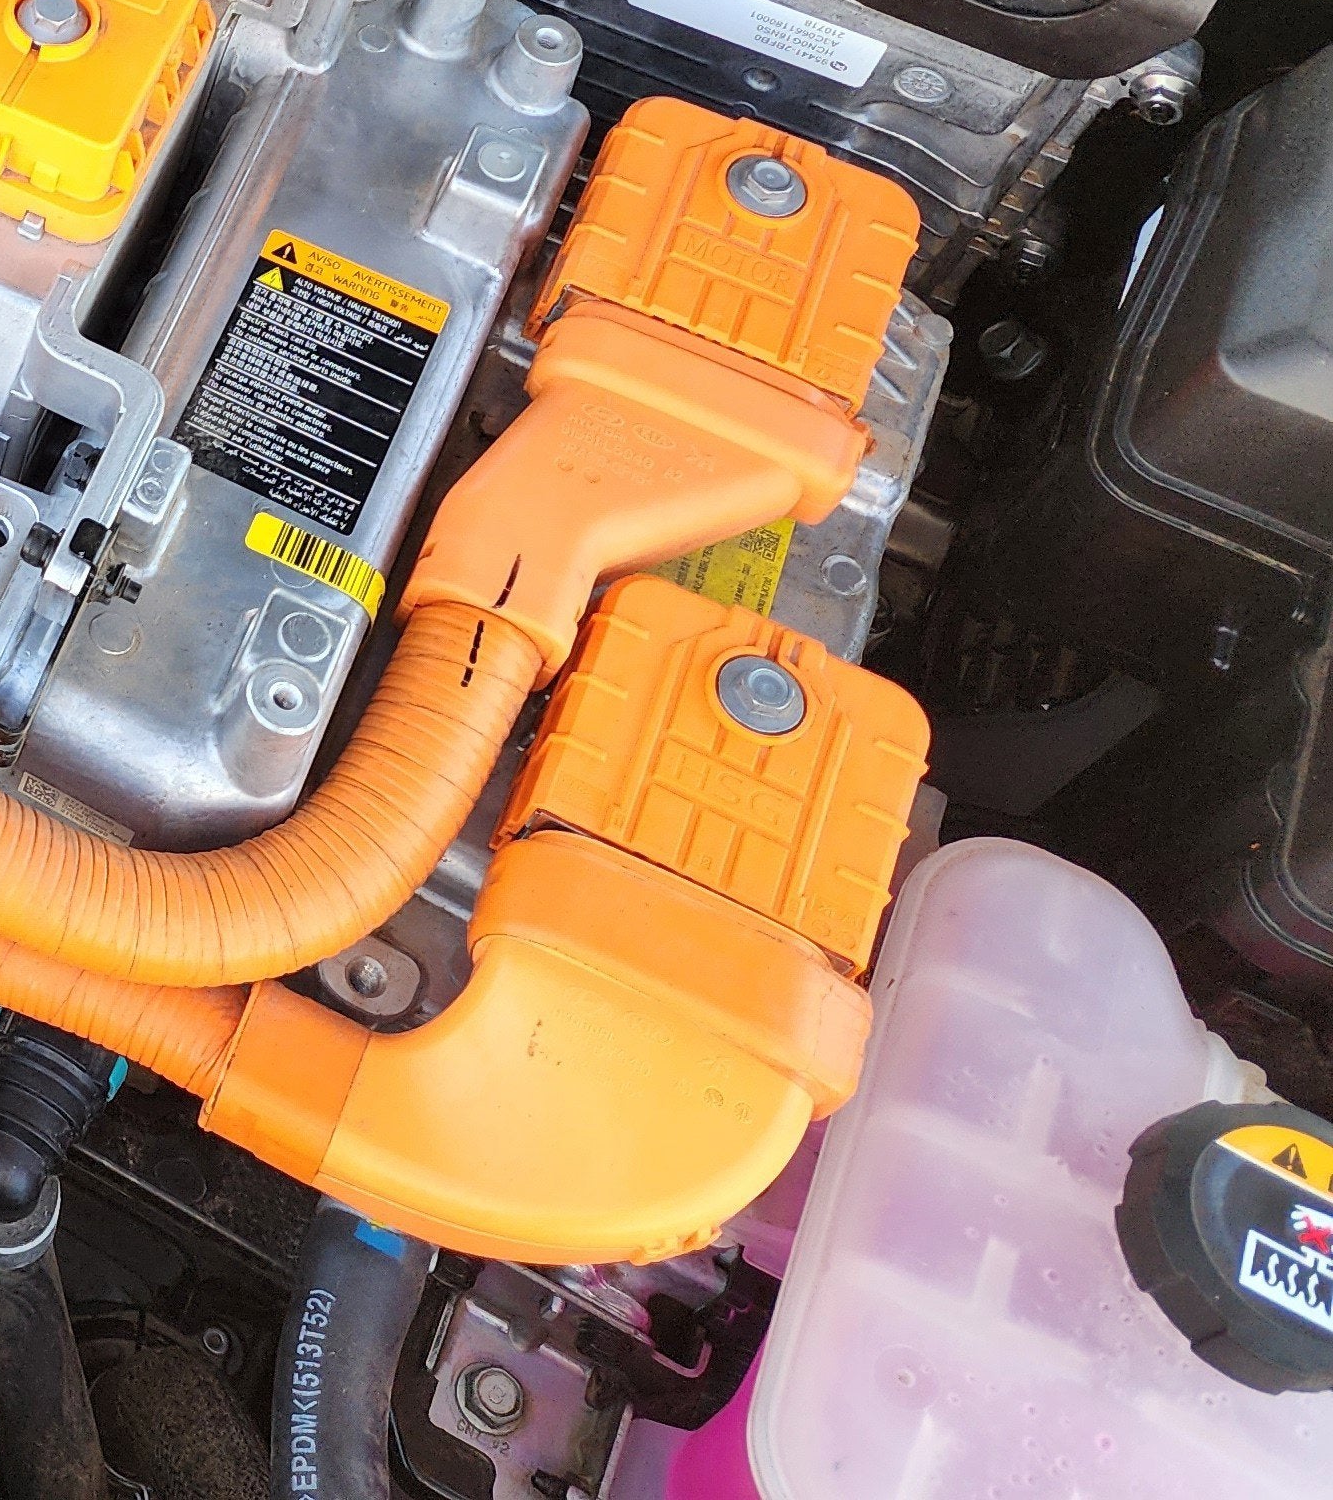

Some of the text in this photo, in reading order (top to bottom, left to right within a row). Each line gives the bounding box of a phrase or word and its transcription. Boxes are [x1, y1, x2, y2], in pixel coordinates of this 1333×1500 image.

[307, 250, 442, 314] AVISO AVERTISSEMENT
[683, 232, 791, 293] MOTOR
[294, 276, 313, 290] ALTO
[312, 284, 342, 303] VOLTAJE
[346, 299, 371, 316] HAUTE
[331, 273, 380, 301] WARNING
[238, 311, 268, 329] Electric
[267, 323, 290, 339] shock
[289, 333, 305, 345] can
[314, 295, 334, 310] HIGH
[332, 303, 362, 322] VOLTAGE
[231, 326, 244, 337] No
[243, 331, 278, 352] customer
[276, 346, 309, 366] serviced
[308, 360, 329, 376] parts
[235, 318, 248, 329] Do
[247, 324, 261, 335] not
[260, 330, 288, 348] remove
[287, 342, 310, 357] cover
[309, 351, 320, 362] or
[200, 389, 226, 406] Risque
[206, 378, 219, 389] No
[218, 384, 255, 406] repuestos
[254, 400, 266, 411] de
[210, 370, 223, 381] No
[221, 376, 253, 395] remover
[252, 390, 284, 409] cubierta
[283, 404, 291, 413] o
[213, 363, 249, 384] Descarga
[280, 393, 305, 409] puede
[197, 397, 209, 409] Ne
[208, 402, 223, 415] pas
[244, 419, 253, 429] le
[286, 438, 298, 449] ou
[297, 443, 310, 455] les
[231, 432, 244, 444] par
[274, 442, 285, 454] pas
[284, 447, 311, 466] aucune
[666, 749, 786, 826] HSG
